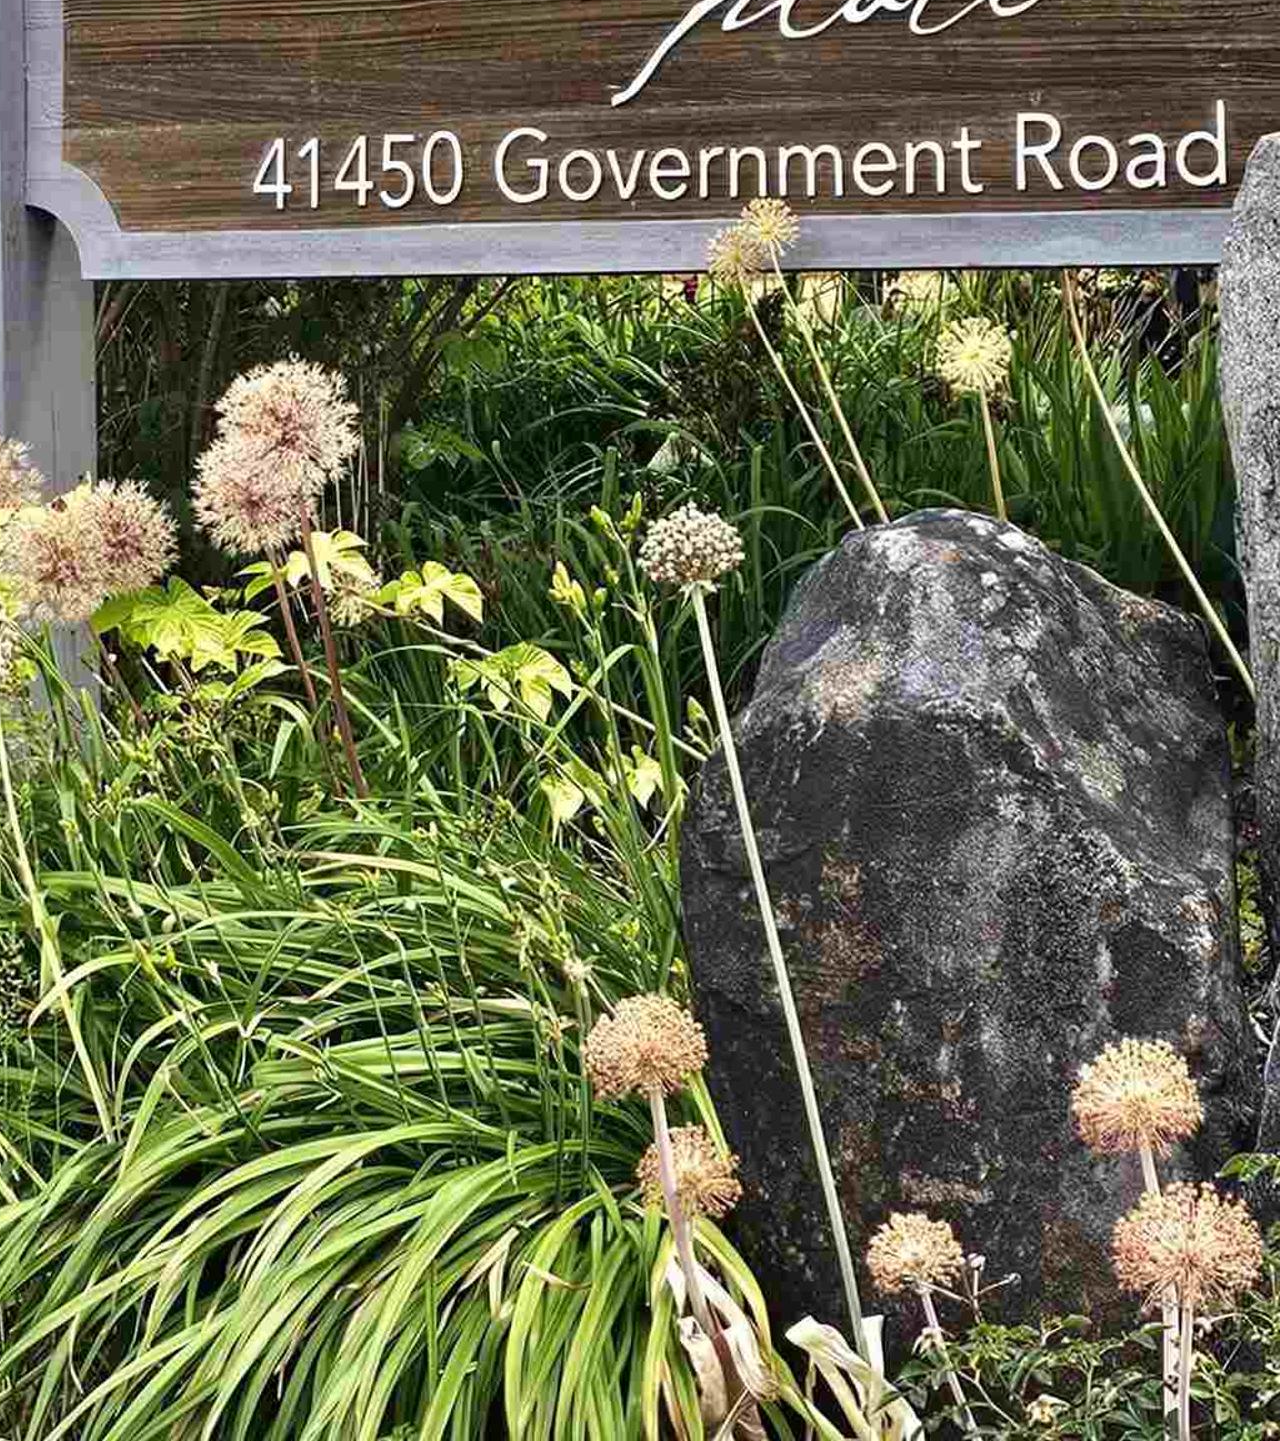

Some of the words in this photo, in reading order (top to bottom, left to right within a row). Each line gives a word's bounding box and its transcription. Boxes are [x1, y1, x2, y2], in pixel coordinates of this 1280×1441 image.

[251, 130, 464, 210] 41450
[493, 126, 984, 203] Government
[1014, 98, 1228, 191] Road
